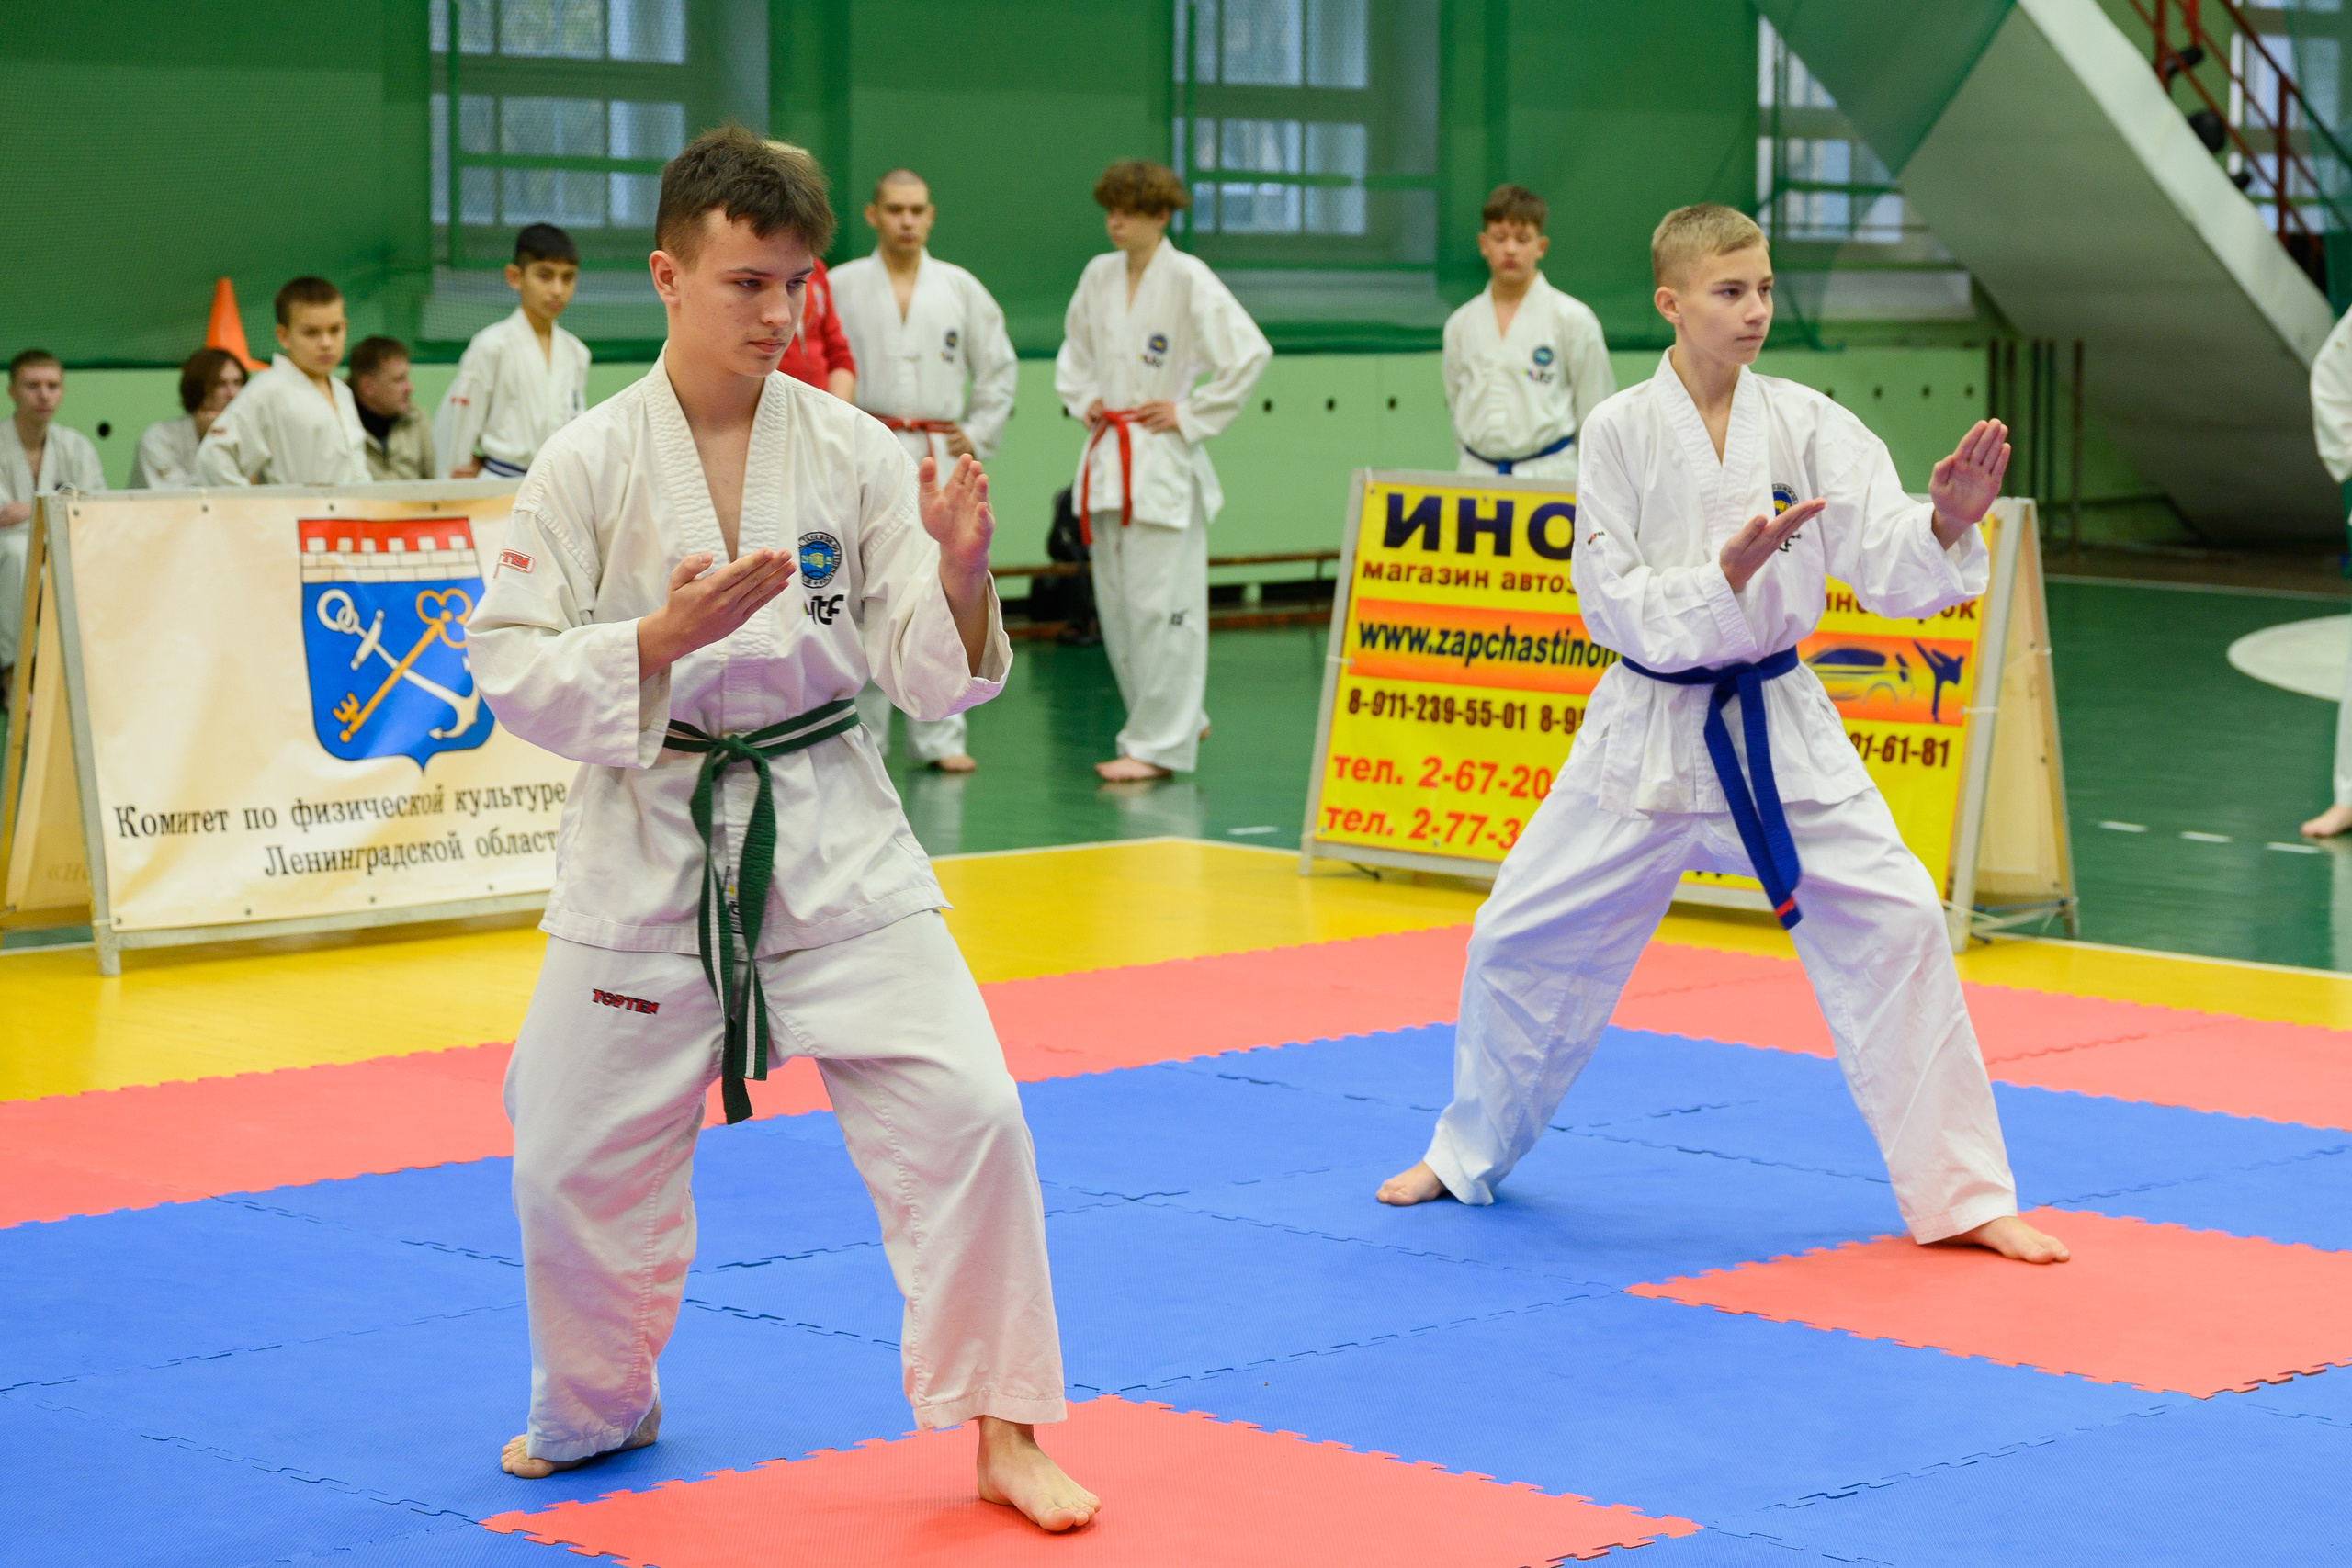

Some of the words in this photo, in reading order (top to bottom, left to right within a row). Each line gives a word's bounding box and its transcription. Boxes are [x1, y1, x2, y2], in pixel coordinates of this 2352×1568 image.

[1363, 560, 1489, 589] магазин
[1348, 688, 1527, 731] 8-911-239-55-01
[1333, 754, 1404, 785] тел.
[1418, 756, 1553, 802] 2-67-20
[114, 803, 230, 838] Комитет
[243, 806, 277, 830] по
[290, 784, 445, 834] физической
[454, 781, 567, 818] культуре
[1325, 806, 1395, 836] тел.
[265, 829, 465, 877] Ленинградской
[592, 988, 661, 1014] TOPTEN
